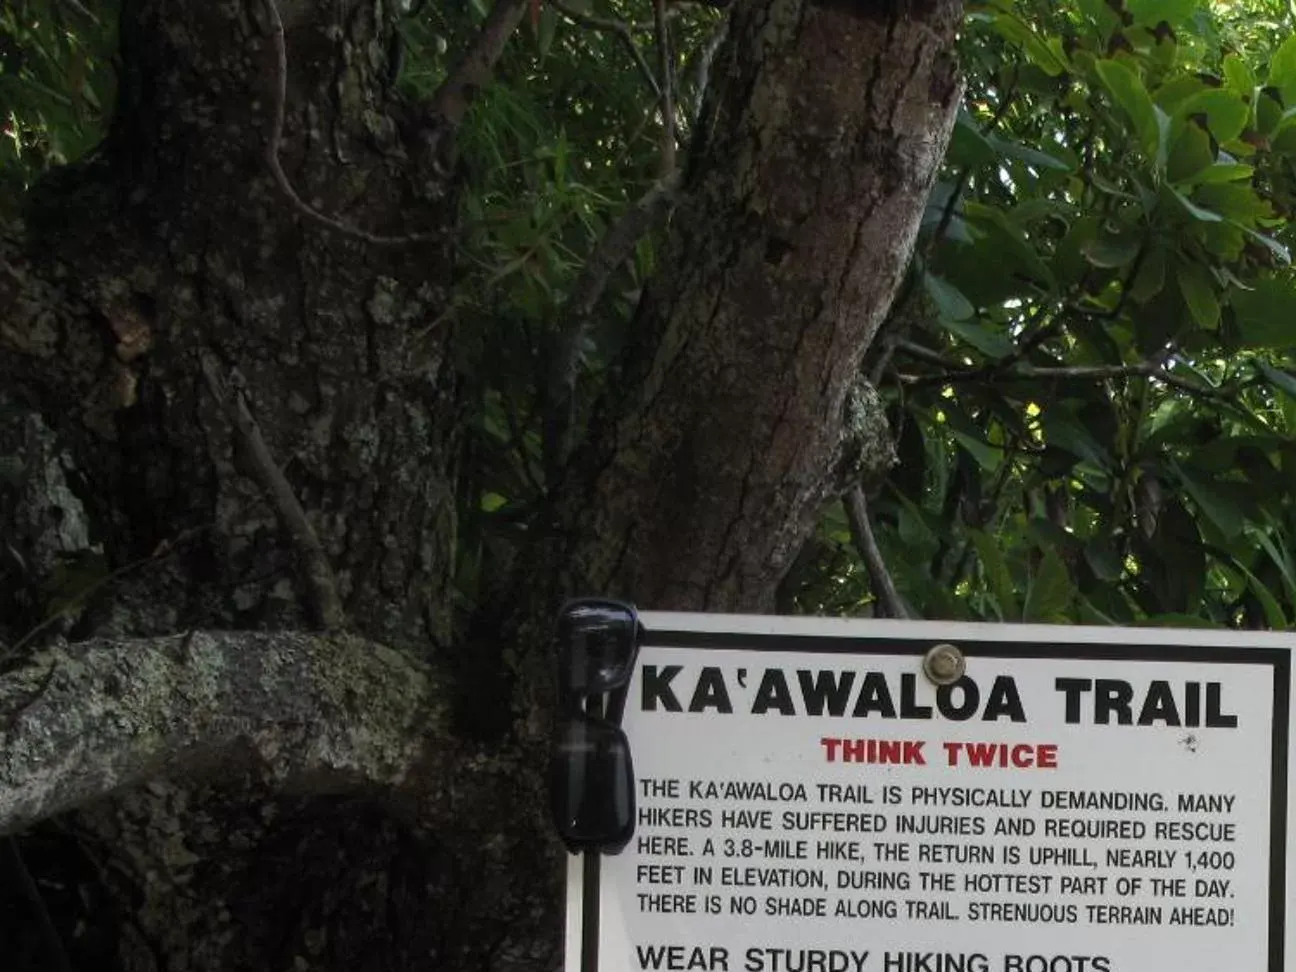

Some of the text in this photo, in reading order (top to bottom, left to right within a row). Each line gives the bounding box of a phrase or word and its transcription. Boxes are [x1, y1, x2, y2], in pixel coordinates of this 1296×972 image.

[1055, 677, 1237, 728] TRAIL
[821, 738, 1057, 768] THINK TWICE
[640, 779, 679, 798] THE
[816, 784, 873, 804] TRAIL
[883, 786, 901, 804] IS
[912, 787, 1032, 808] PHYSICALLY
[1041, 791, 1168, 811] DEMANDING.
[1178, 795, 1235, 813] MANY
[639, 808, 1235, 841] HIKERS HAVE SUFFERED INJURIES AND REQUIRED RESCUE
[638, 836, 1234, 870] HERE. A 3.8-MILE HIKE, THE RETURN IS UPHILL, NEARLY 1,400
[637, 865, 1234, 898] FEET IN ELEVATION, DURING THE HOTTEST PART OF THE DAY.
[637, 894, 1234, 926] THERE IS NO SHADE ALONG TRAIL. STRENUOUS TERRAIN AHEAD!
[636, 946, 728, 972] WEAR
